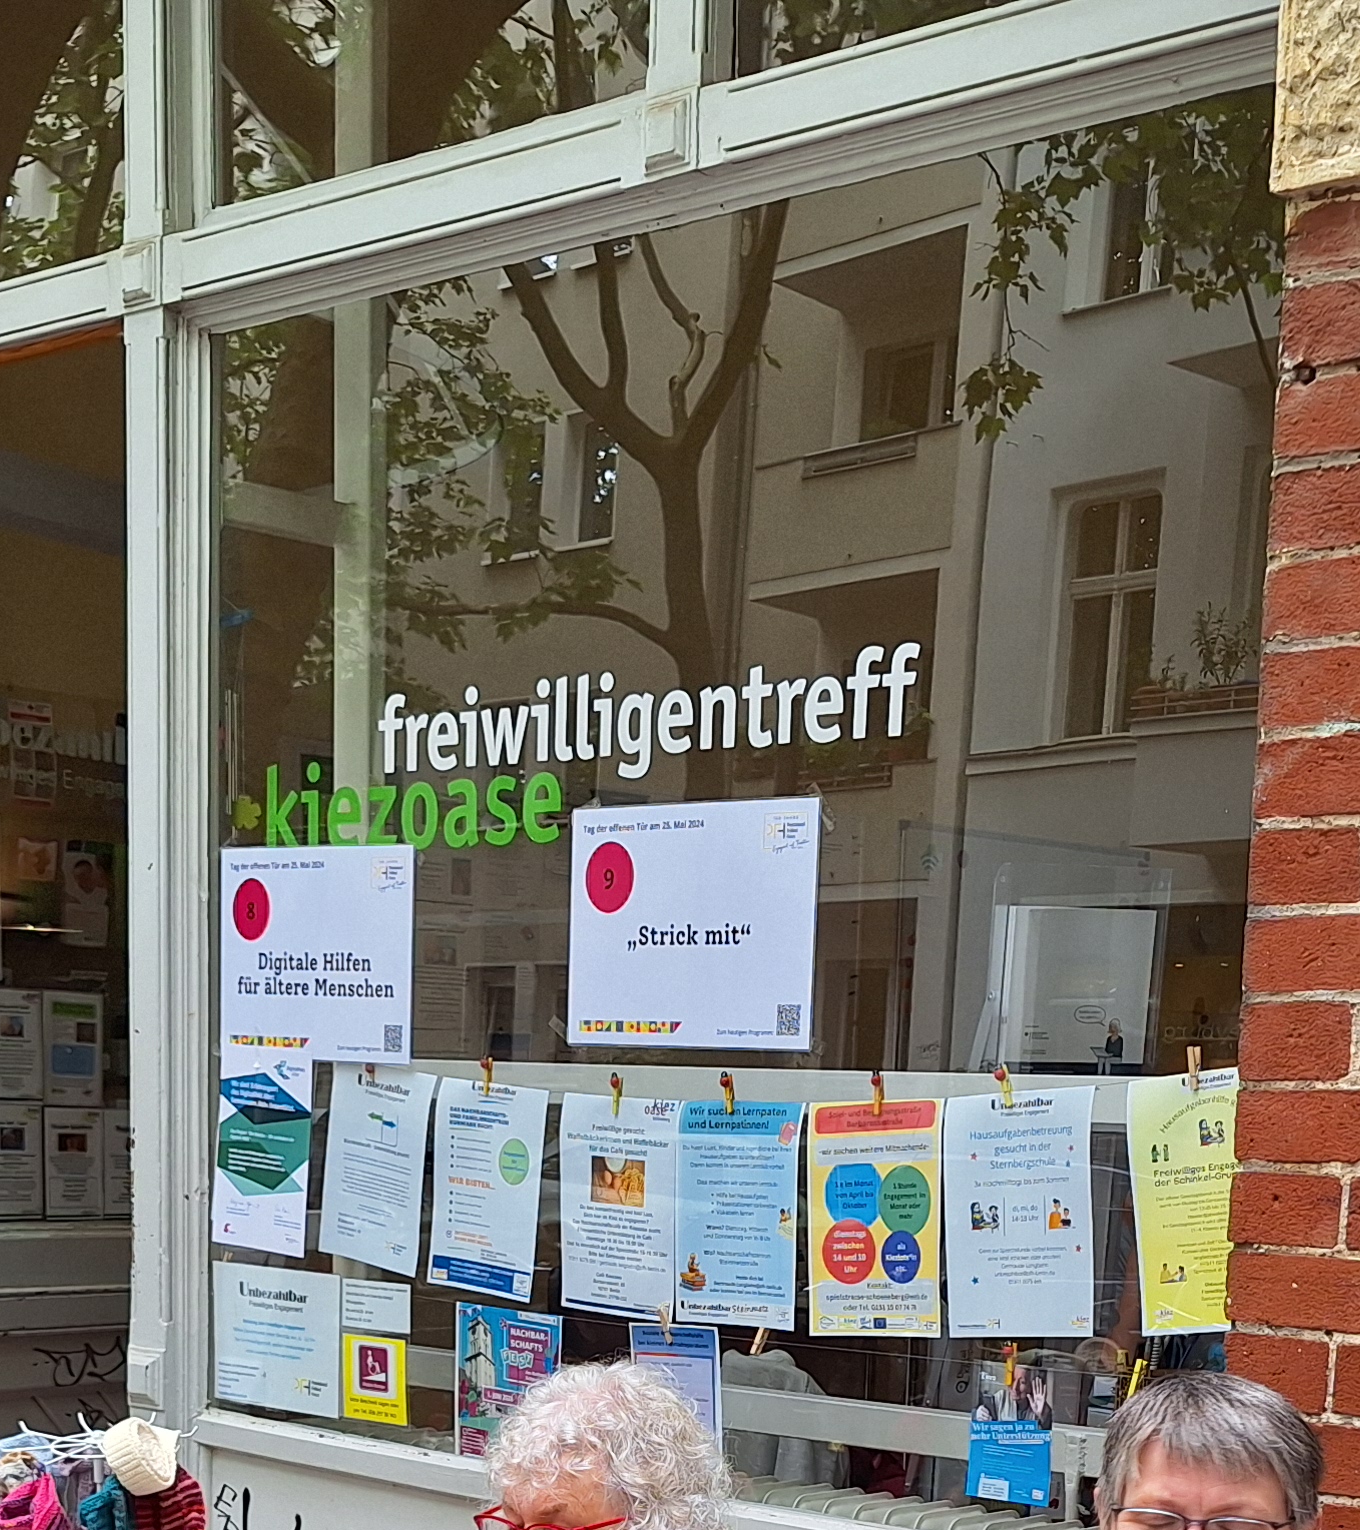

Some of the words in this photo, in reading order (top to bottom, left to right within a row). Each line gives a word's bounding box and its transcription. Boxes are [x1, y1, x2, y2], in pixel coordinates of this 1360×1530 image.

[378, 641, 921, 780] freiwilligentreff
[266, 761, 563, 850] kiezoase
[583, 824, 595, 835] Tag
[596, 824, 607, 833] der
[608, 823, 635, 833] offenen
[636, 821, 648, 831] Tür
[649, 823, 660, 831] am
[674, 820, 687, 830] Mai
[688, 819, 705, 829] 2024
[603, 868, 614, 890] 9
[246, 902, 256, 920] 8
[627, 924, 699, 952] „Strick
[705, 922, 751, 946] mit“
[258, 951, 318, 975] Digitale
[322, 952, 372, 972] Hilfen
[237, 975, 260, 995] für
[264, 977, 310, 996] ältere
[314, 978, 395, 998] Menschen
[689, 1106, 705, 1117] Wir
[742, 1107, 788, 1119] Lernpaten
[687, 1119, 706, 1130] und
[708, 1119, 769, 1132] Lernpatinnen!
[969, 1125, 1073, 1141] Hausaufgabenbetreuung
[994, 1143, 1027, 1156] gesucht
[1029, 1143, 1036, 1152] in
[1038, 1142, 1051, 1151] der
[989, 1156, 1056, 1171] Sternbergschule
[239, 1280, 309, 1304] Unbezahlbar
[509, 1326, 549, 1342] NACHBAR-
[509, 1339, 544, 1353] SCHAFTS
[501, 1349, 534, 1369] FEST
[972, 1422, 989, 1431] Wir
[990, 1423, 1014, 1432] sagen
[1015, 1423, 1023, 1431] ja
